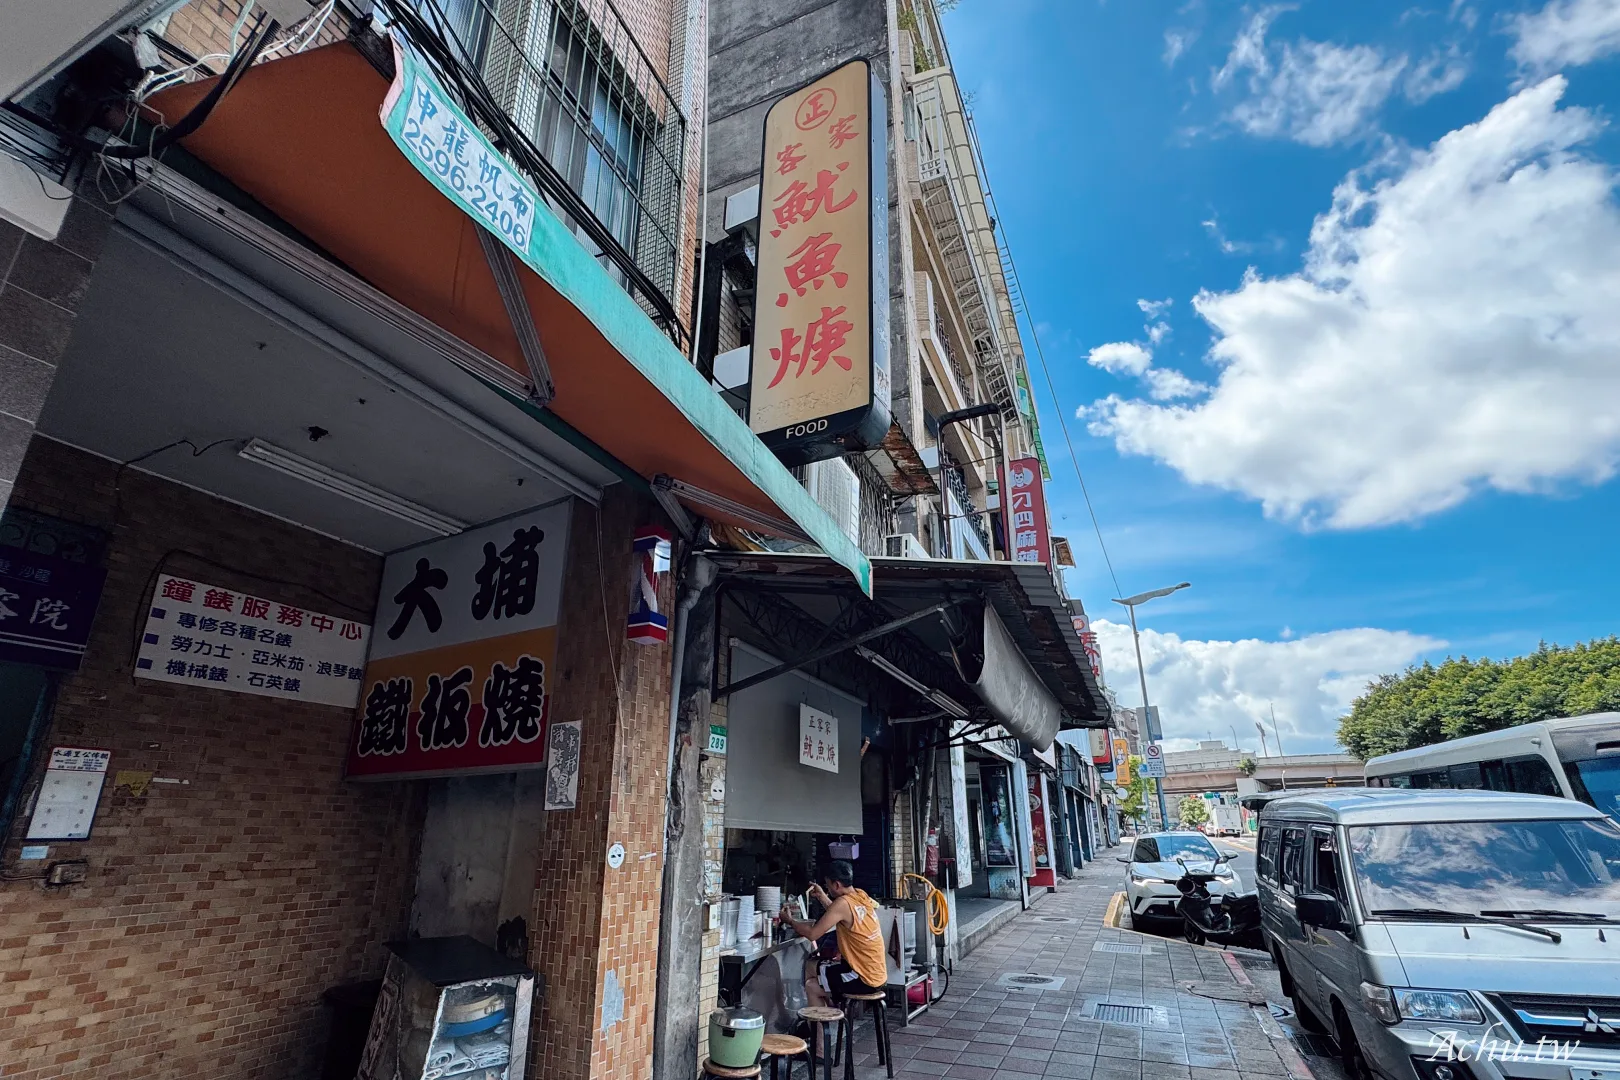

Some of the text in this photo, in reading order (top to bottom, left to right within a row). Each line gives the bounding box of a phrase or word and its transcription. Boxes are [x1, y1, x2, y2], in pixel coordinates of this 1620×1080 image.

[798, 89, 834, 129] 正
[416, 85, 531, 219] 申龍帆布
[775, 114, 860, 176] 客家
[404, 118, 526, 248] 2596-2406
[767, 162, 858, 389] 魷魚焿
[786, 420, 828, 439] FOOD
[161, 578, 363, 641] 鐘錶服務中心
[387, 525, 544, 640] 大埔
[176, 612, 293, 648] 專修各種名錶
[358, 654, 545, 758] 鐵板燒
[710, 736, 725, 750] 289
